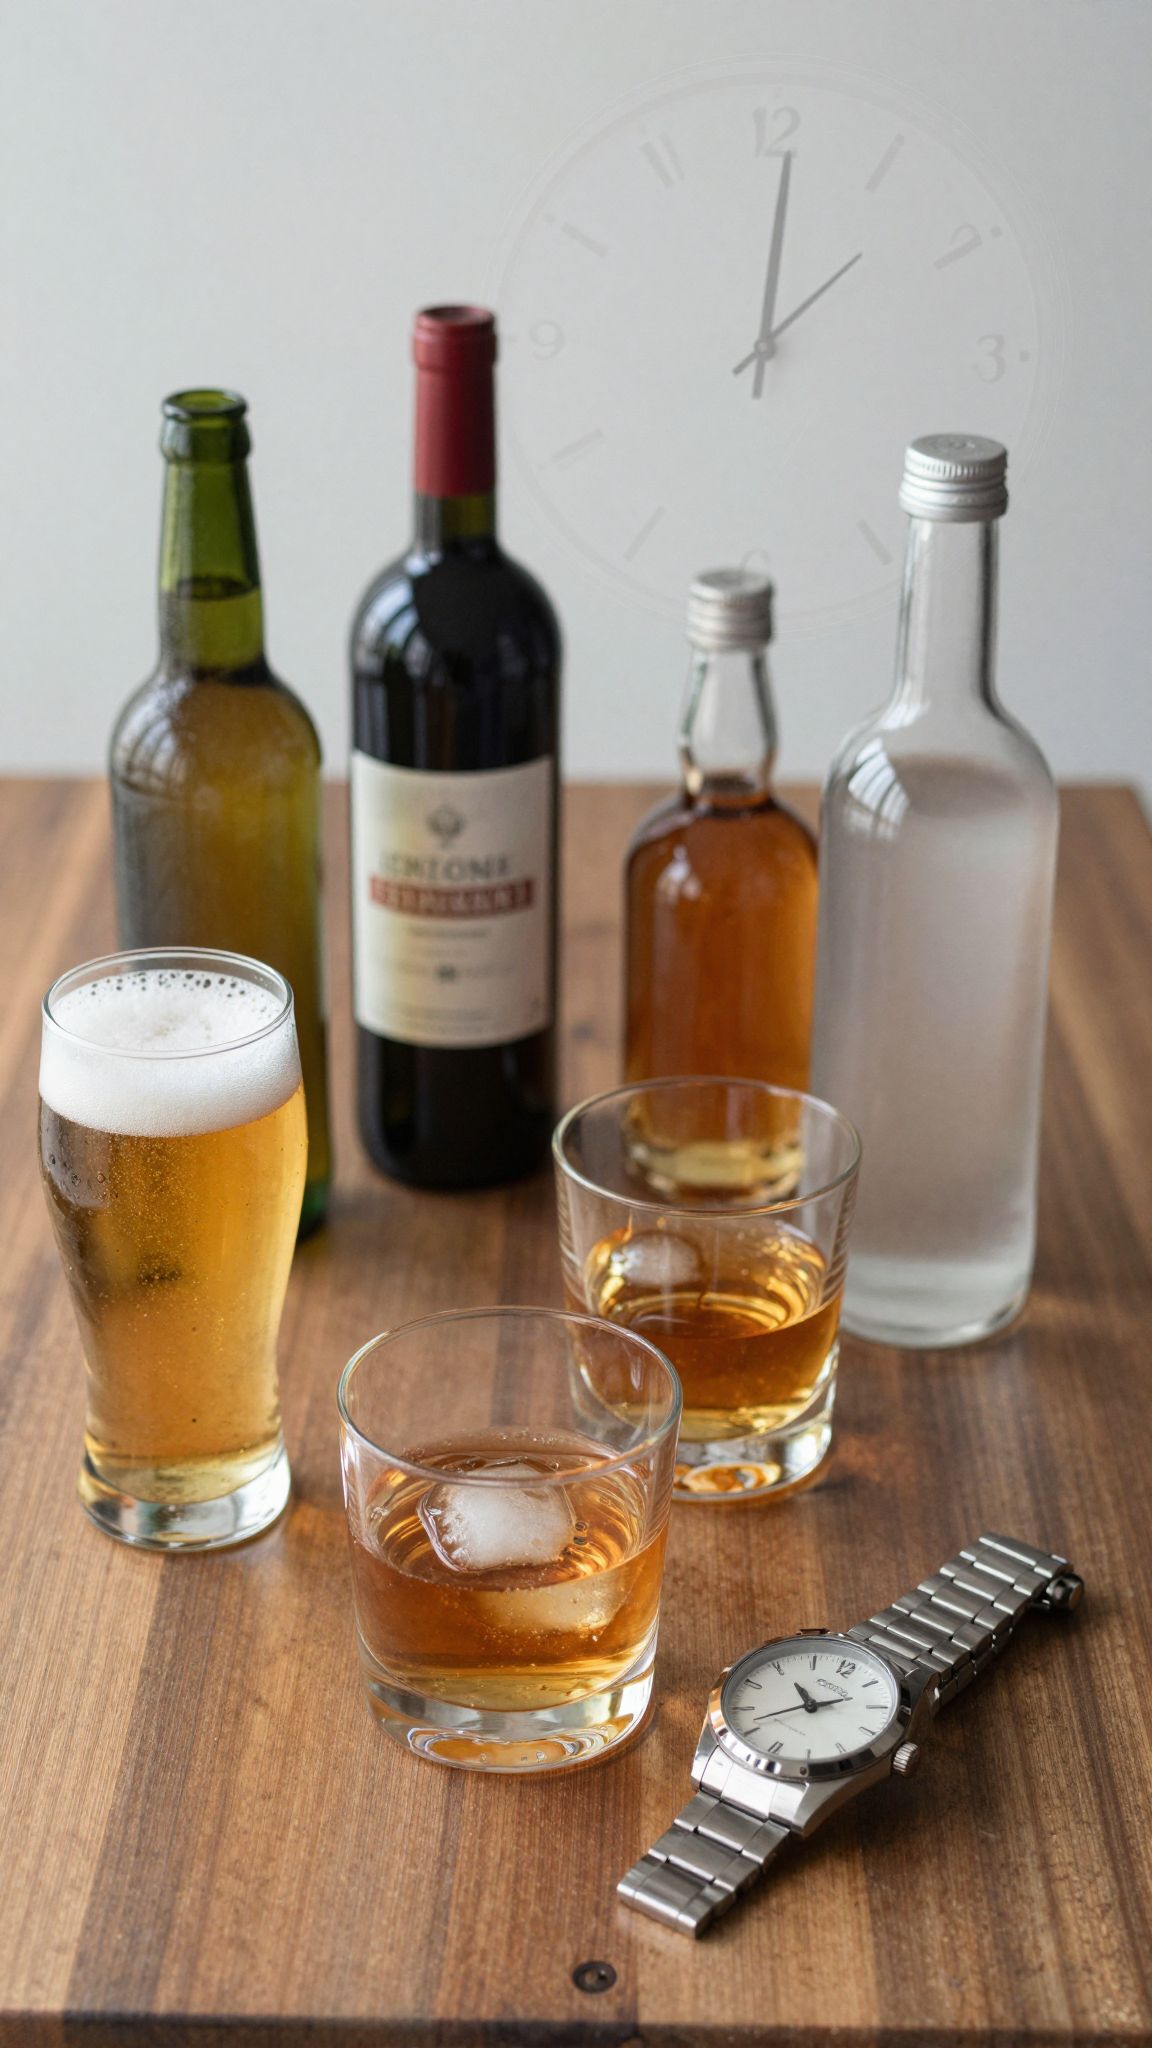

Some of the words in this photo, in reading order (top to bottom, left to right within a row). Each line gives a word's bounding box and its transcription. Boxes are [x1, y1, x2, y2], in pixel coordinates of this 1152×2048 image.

[752, 106, 801, 159] 12
[528, 319, 566, 361] 9
[971, 333, 1006, 383] 3
[836, 1659, 856, 1679] 12
